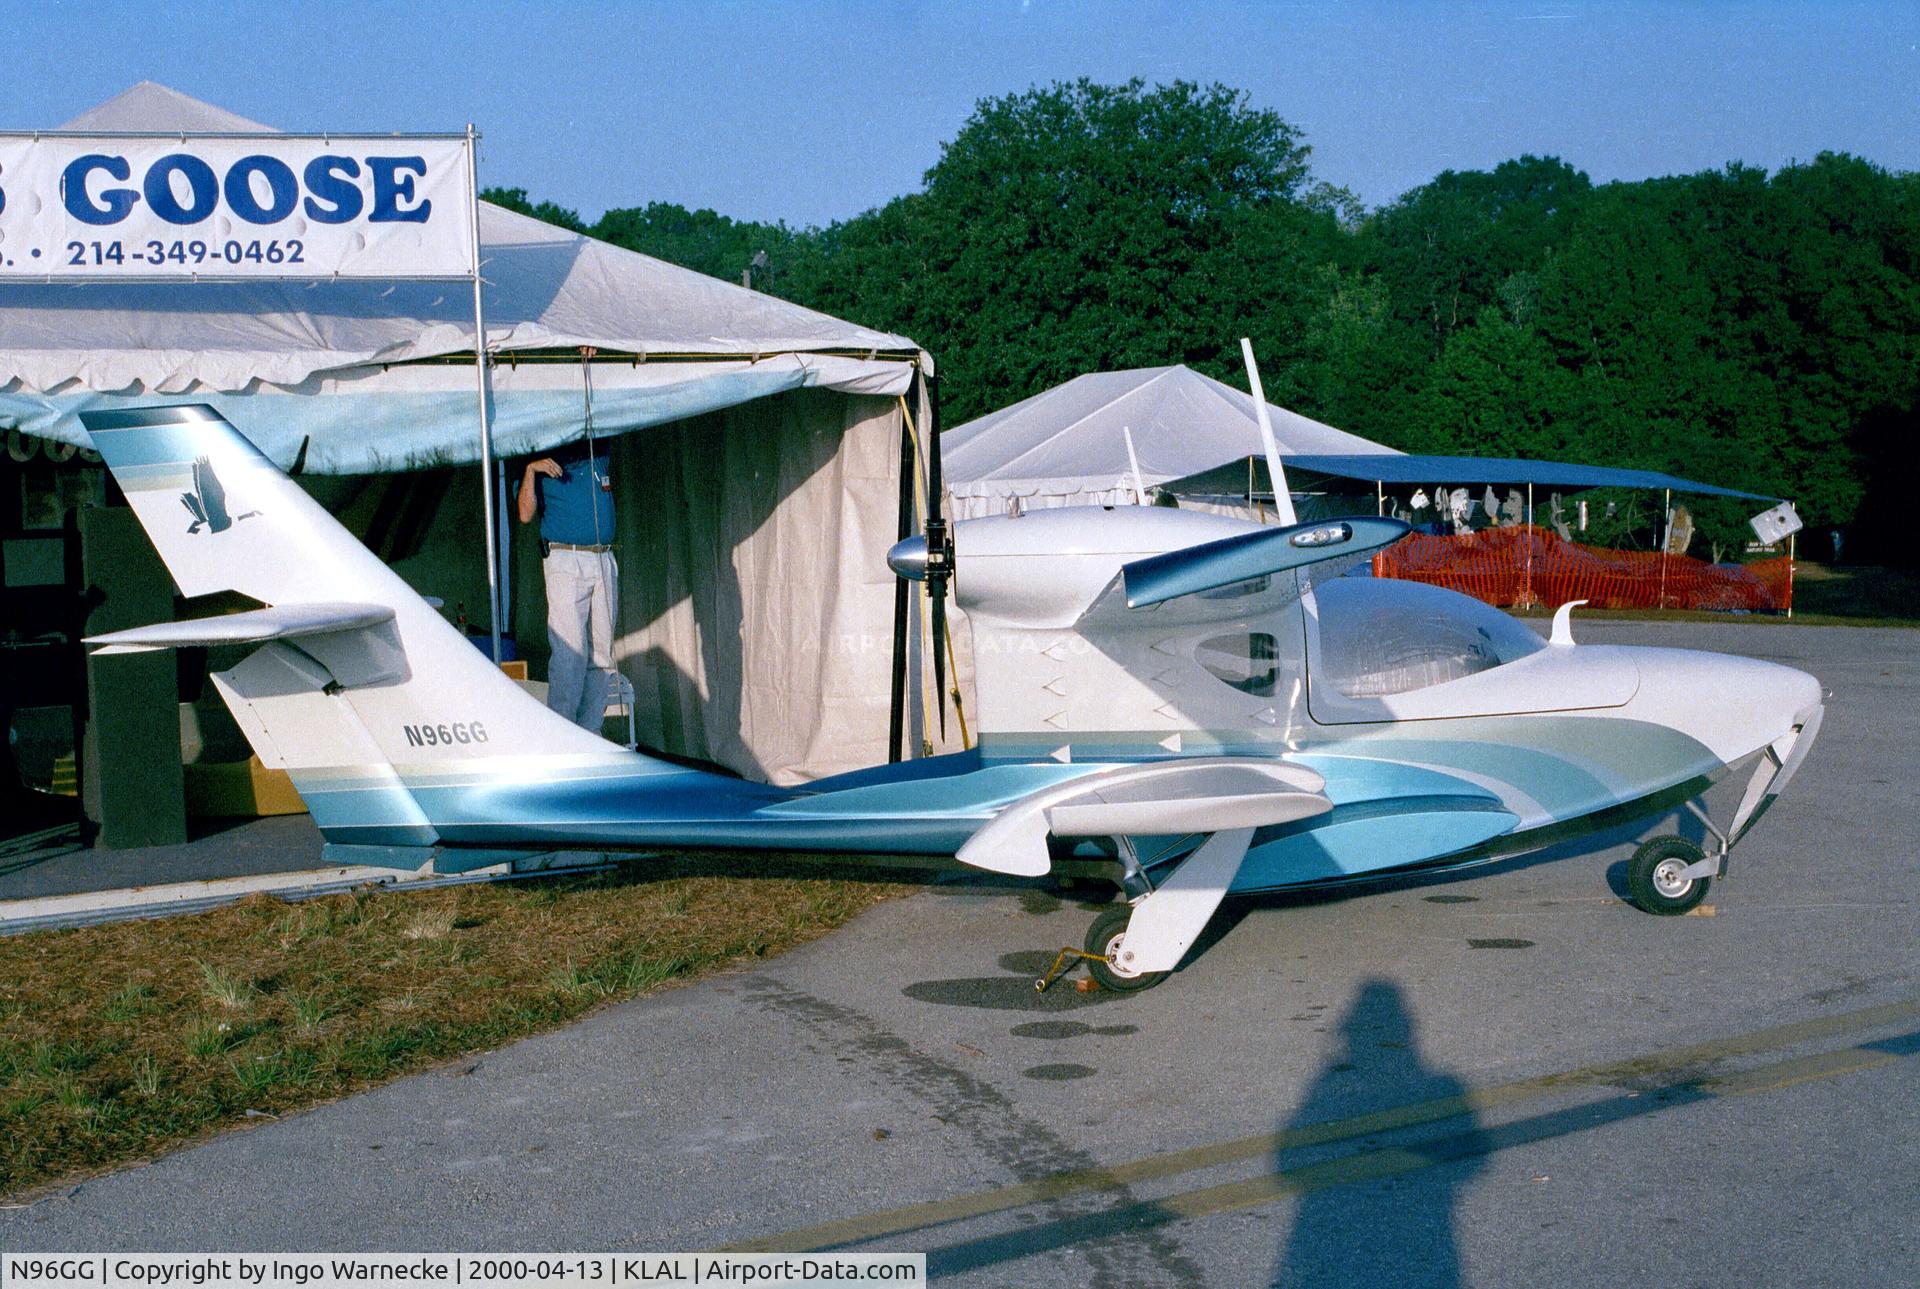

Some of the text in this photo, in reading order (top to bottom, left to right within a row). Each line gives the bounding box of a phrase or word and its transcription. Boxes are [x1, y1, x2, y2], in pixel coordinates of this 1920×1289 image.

[59, 154, 431, 225] GOOSE
[67, 240, 305, 266] 214-349-0462
[403, 721, 489, 747] N96GG
